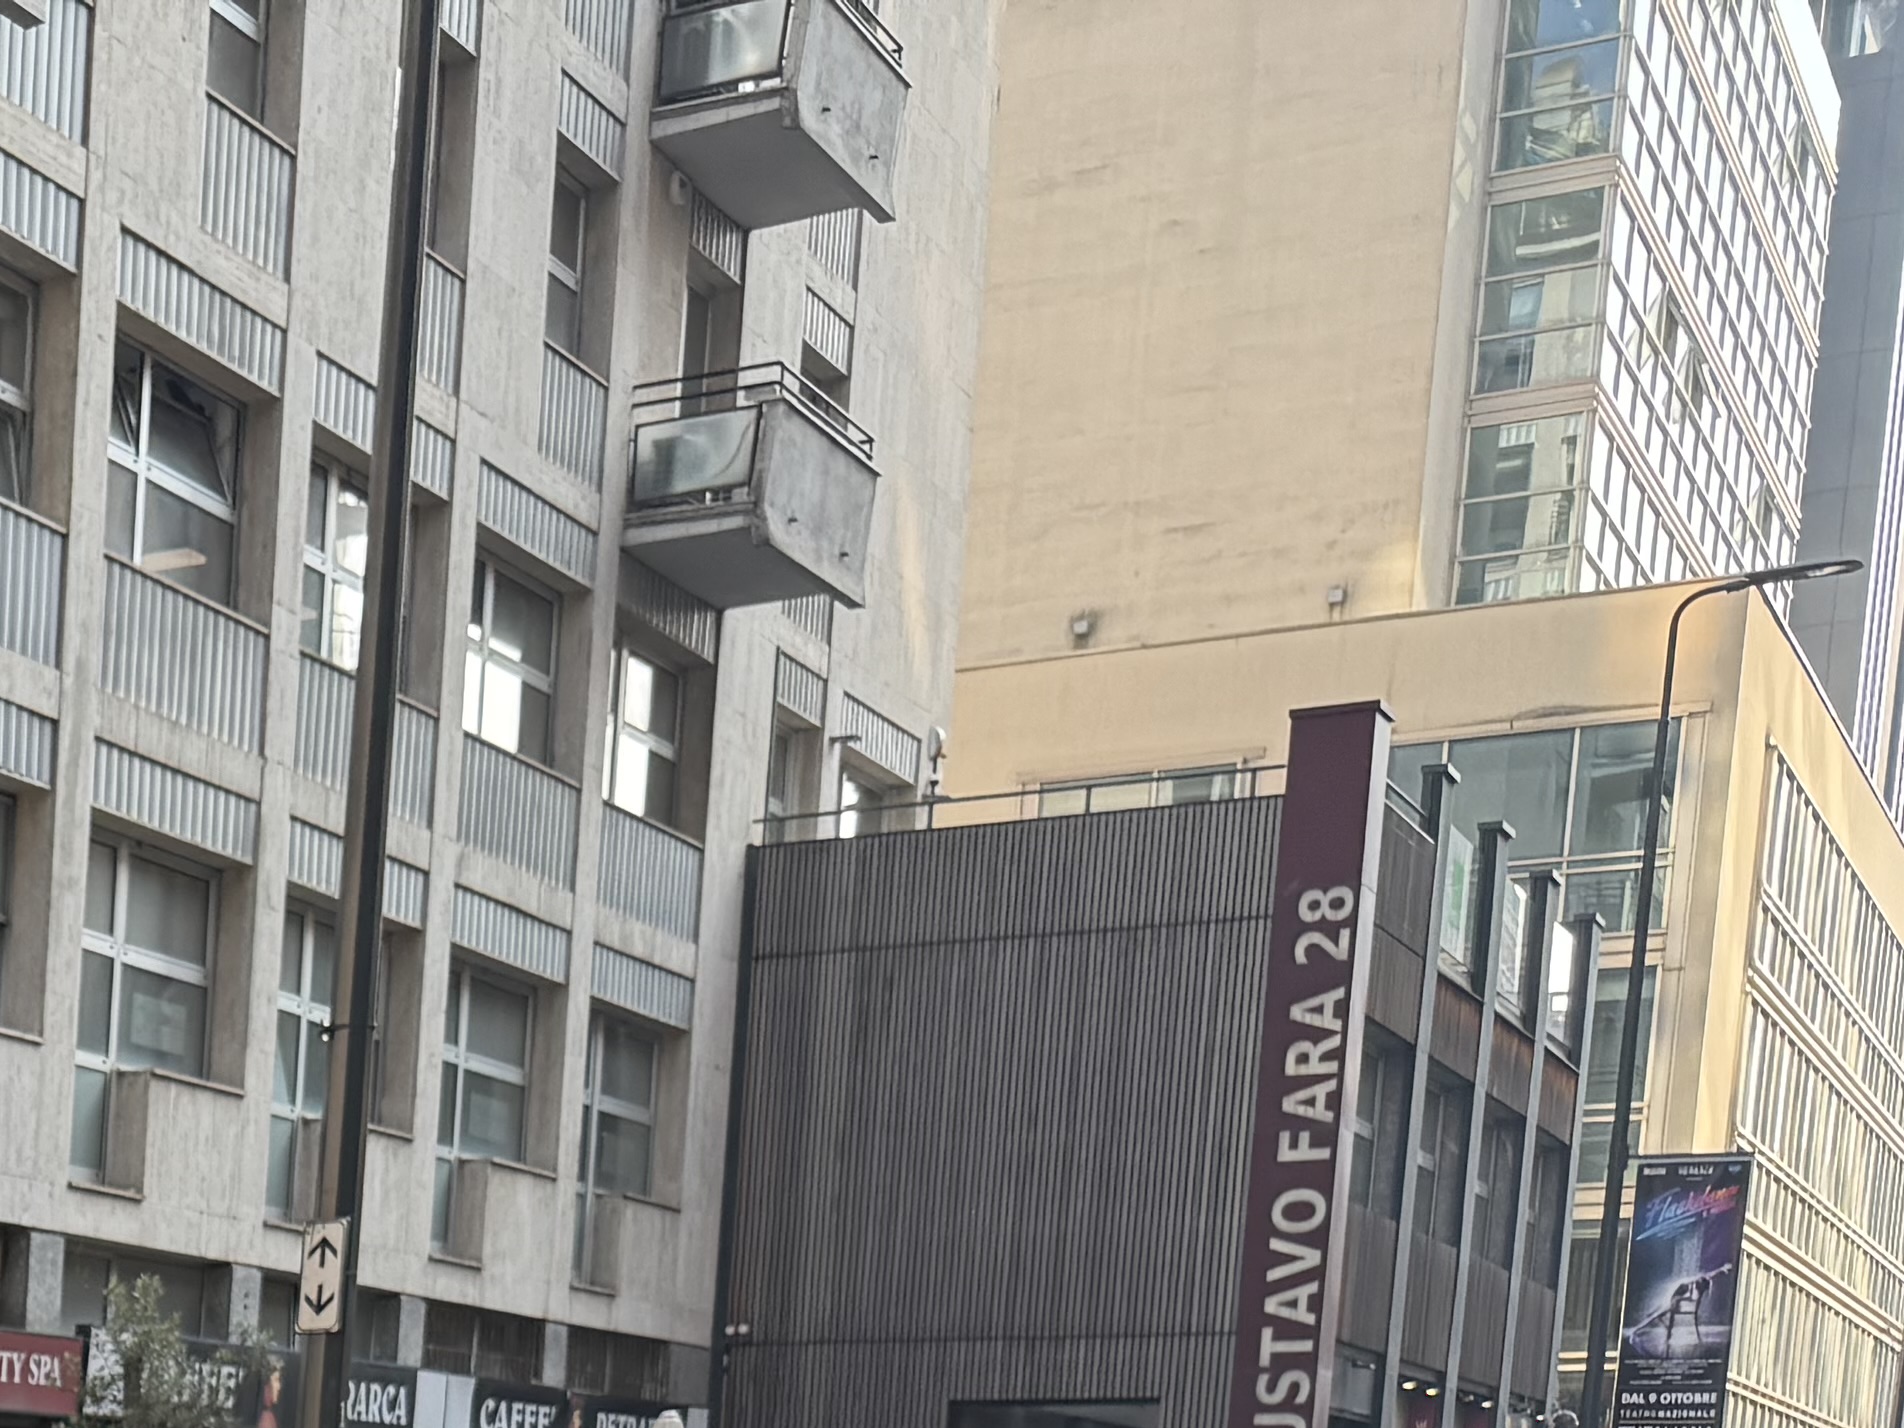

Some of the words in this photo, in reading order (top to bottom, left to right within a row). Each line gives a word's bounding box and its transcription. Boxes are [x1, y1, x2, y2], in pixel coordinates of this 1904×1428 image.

[1295, 884, 1355, 965] 28
[1278, 985, 1347, 1162] FARA
[27, 1353, 62, 1389] SPA
[1621, 1392, 1645, 1405] DAL
[1660, 1392, 1718, 1405] OTTOBRE
